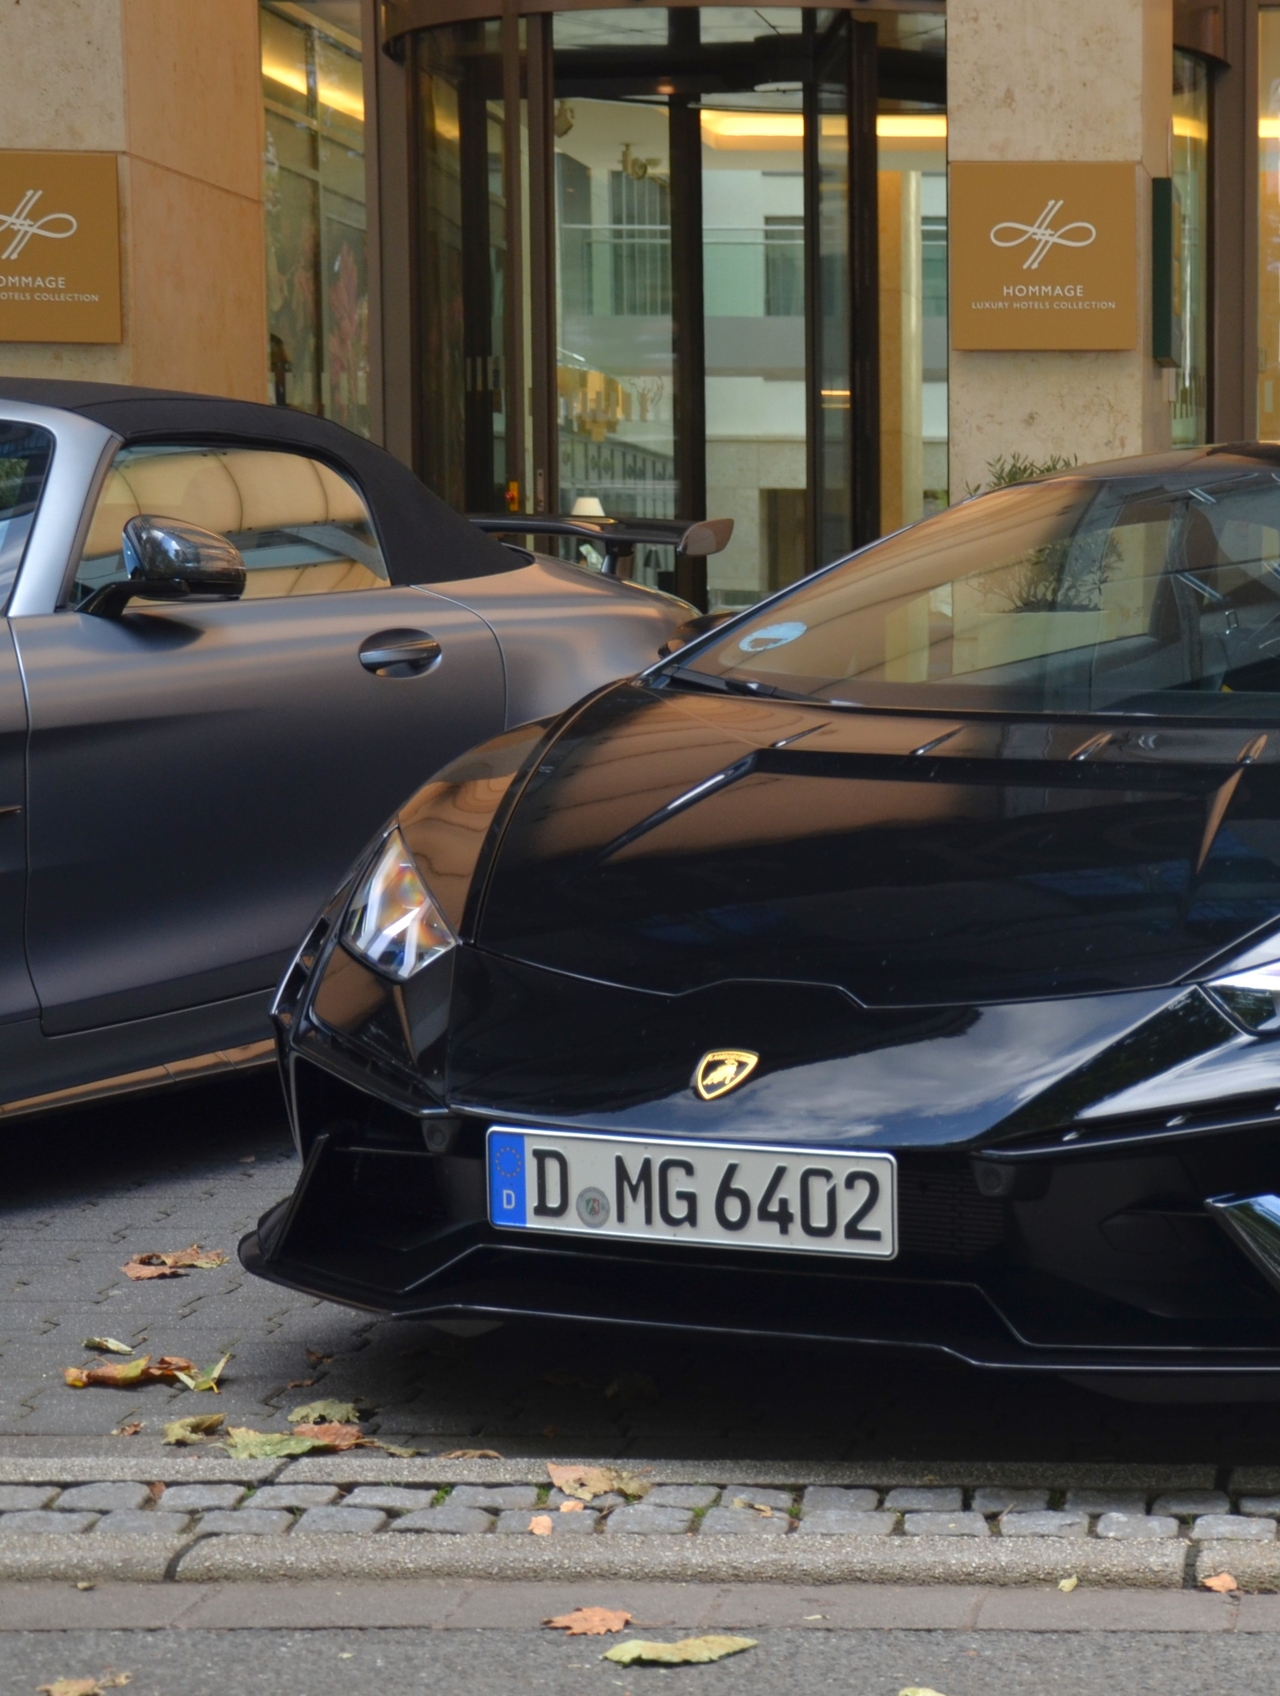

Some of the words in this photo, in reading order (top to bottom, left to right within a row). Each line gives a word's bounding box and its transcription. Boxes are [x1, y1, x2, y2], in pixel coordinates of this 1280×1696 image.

[1003, 285, 1084, 297] HOMMAGE
[34, 293, 100, 302] COLLECTION
[971, 301, 1009, 309] LUXURY
[1013, 301, 1050, 309] HOTELS
[1053, 301, 1116, 309] COLLECTION
[502, 1189, 516, 1210] D
[532, 1148, 569, 1218] D
[614, 1154, 698, 1228] MG
[713, 1162, 882, 1242] 6402
